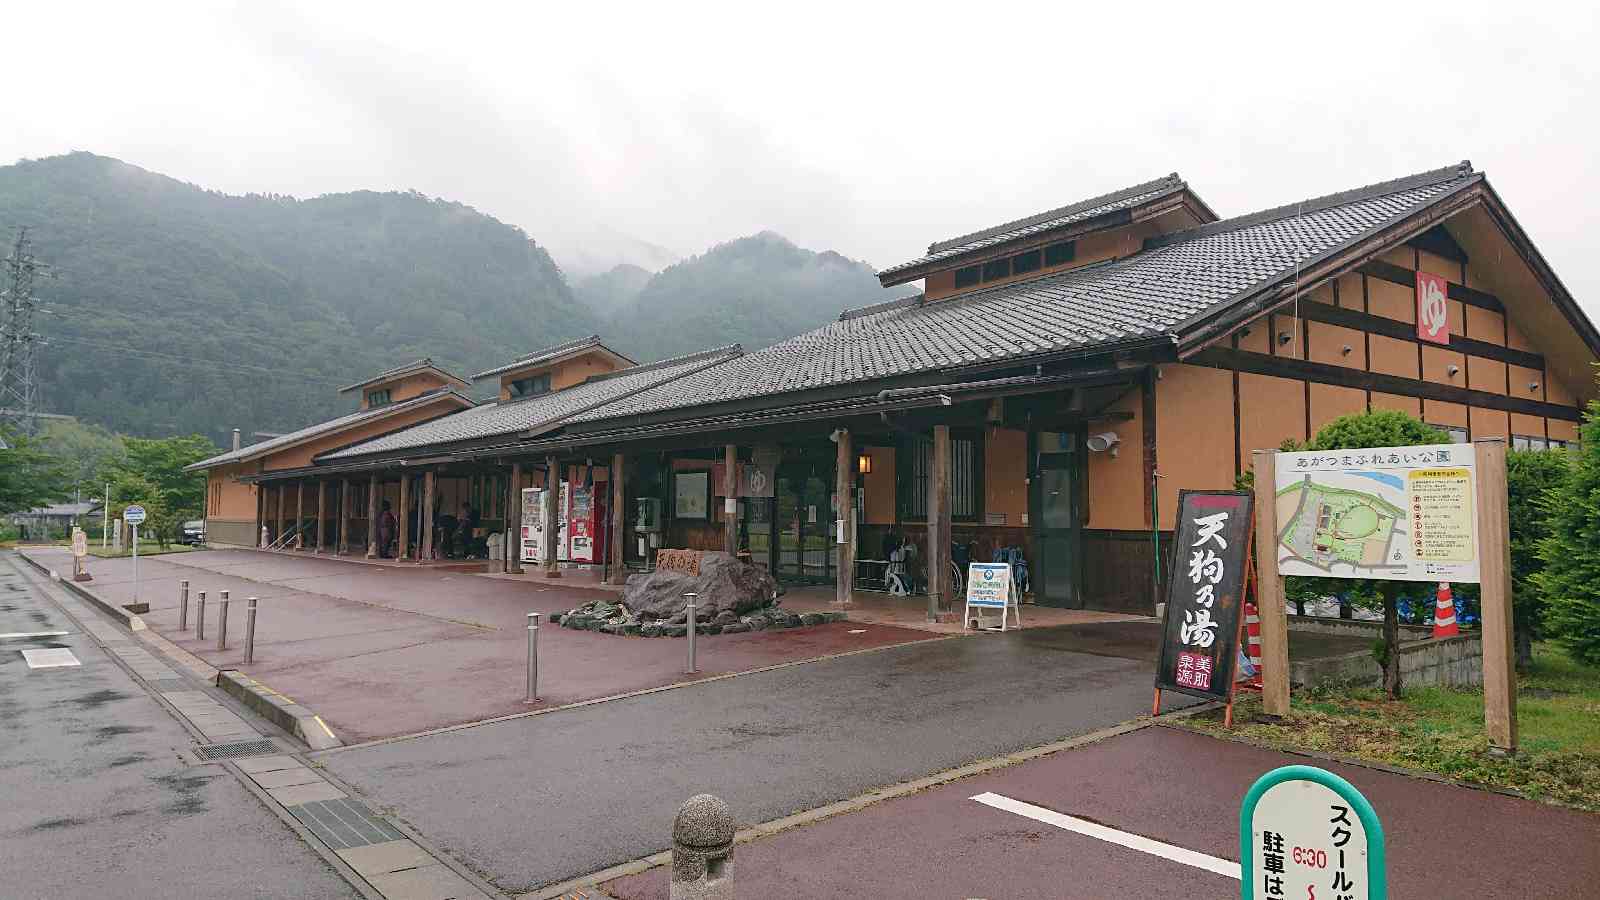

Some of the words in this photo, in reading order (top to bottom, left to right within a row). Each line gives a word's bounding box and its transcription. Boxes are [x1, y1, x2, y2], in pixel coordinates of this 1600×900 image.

[1421, 279, 1446, 336] ゆ
[1297, 450, 1450, 468] あがつまふれあい公園
[1181, 511, 1229, 648] 天狗乃湯
[1262, 831, 1285, 900] 駐車は
[1293, 847, 1326, 868] 6:30
[1330, 805, 1353, 900] スクール
